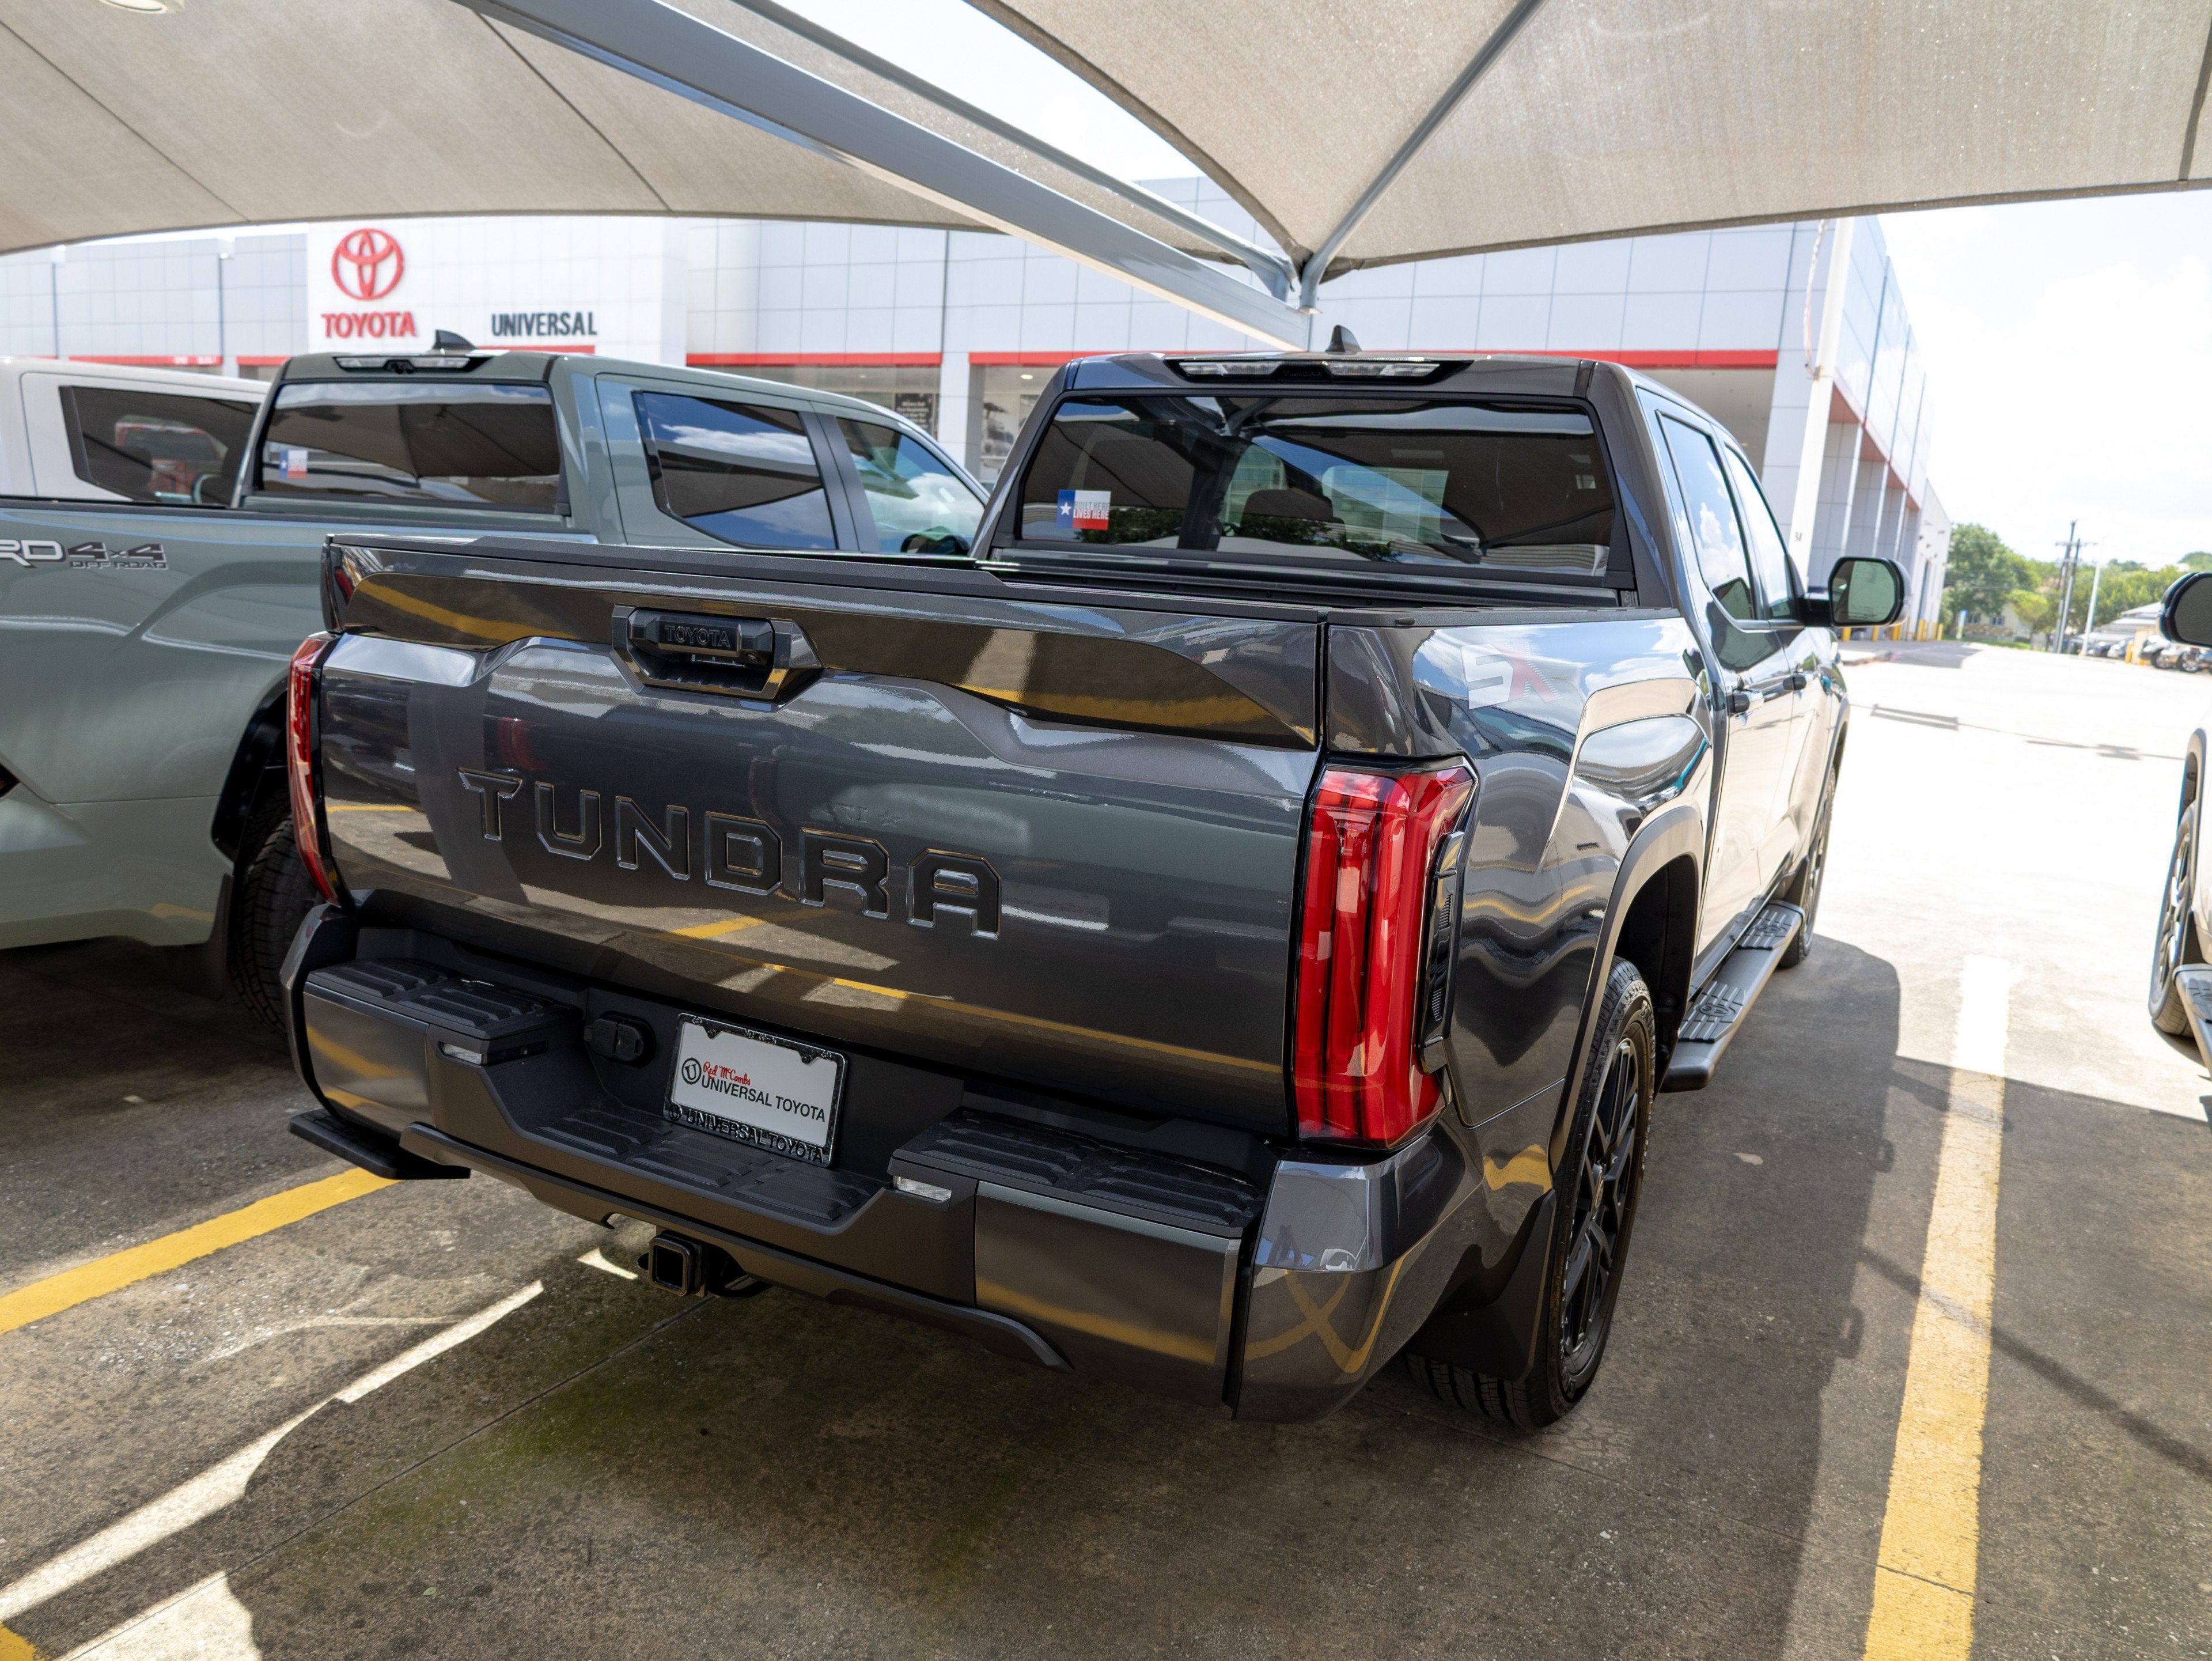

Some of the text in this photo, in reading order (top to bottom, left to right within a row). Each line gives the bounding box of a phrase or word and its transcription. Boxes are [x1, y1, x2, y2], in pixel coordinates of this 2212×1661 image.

[321, 311, 416, 338] TOYOTA
[491, 311, 597, 336] UNIVERSAL
[1073, 509, 1109, 520] LIVES HERE
[1075, 501, 1111, 511] BUILT HERE
[70, 561, 169, 570] OFF ROAD
[664, 625, 731, 648] TOYOTA
[456, 766, 1002, 940] TUNDRA
[703, 1061, 751, 1085] Red McCombs
[701, 1076, 826, 1122] UNIVERSAL TOYOTA
[686, 1109, 824, 1163] UNIVERSAL TOYOTA
